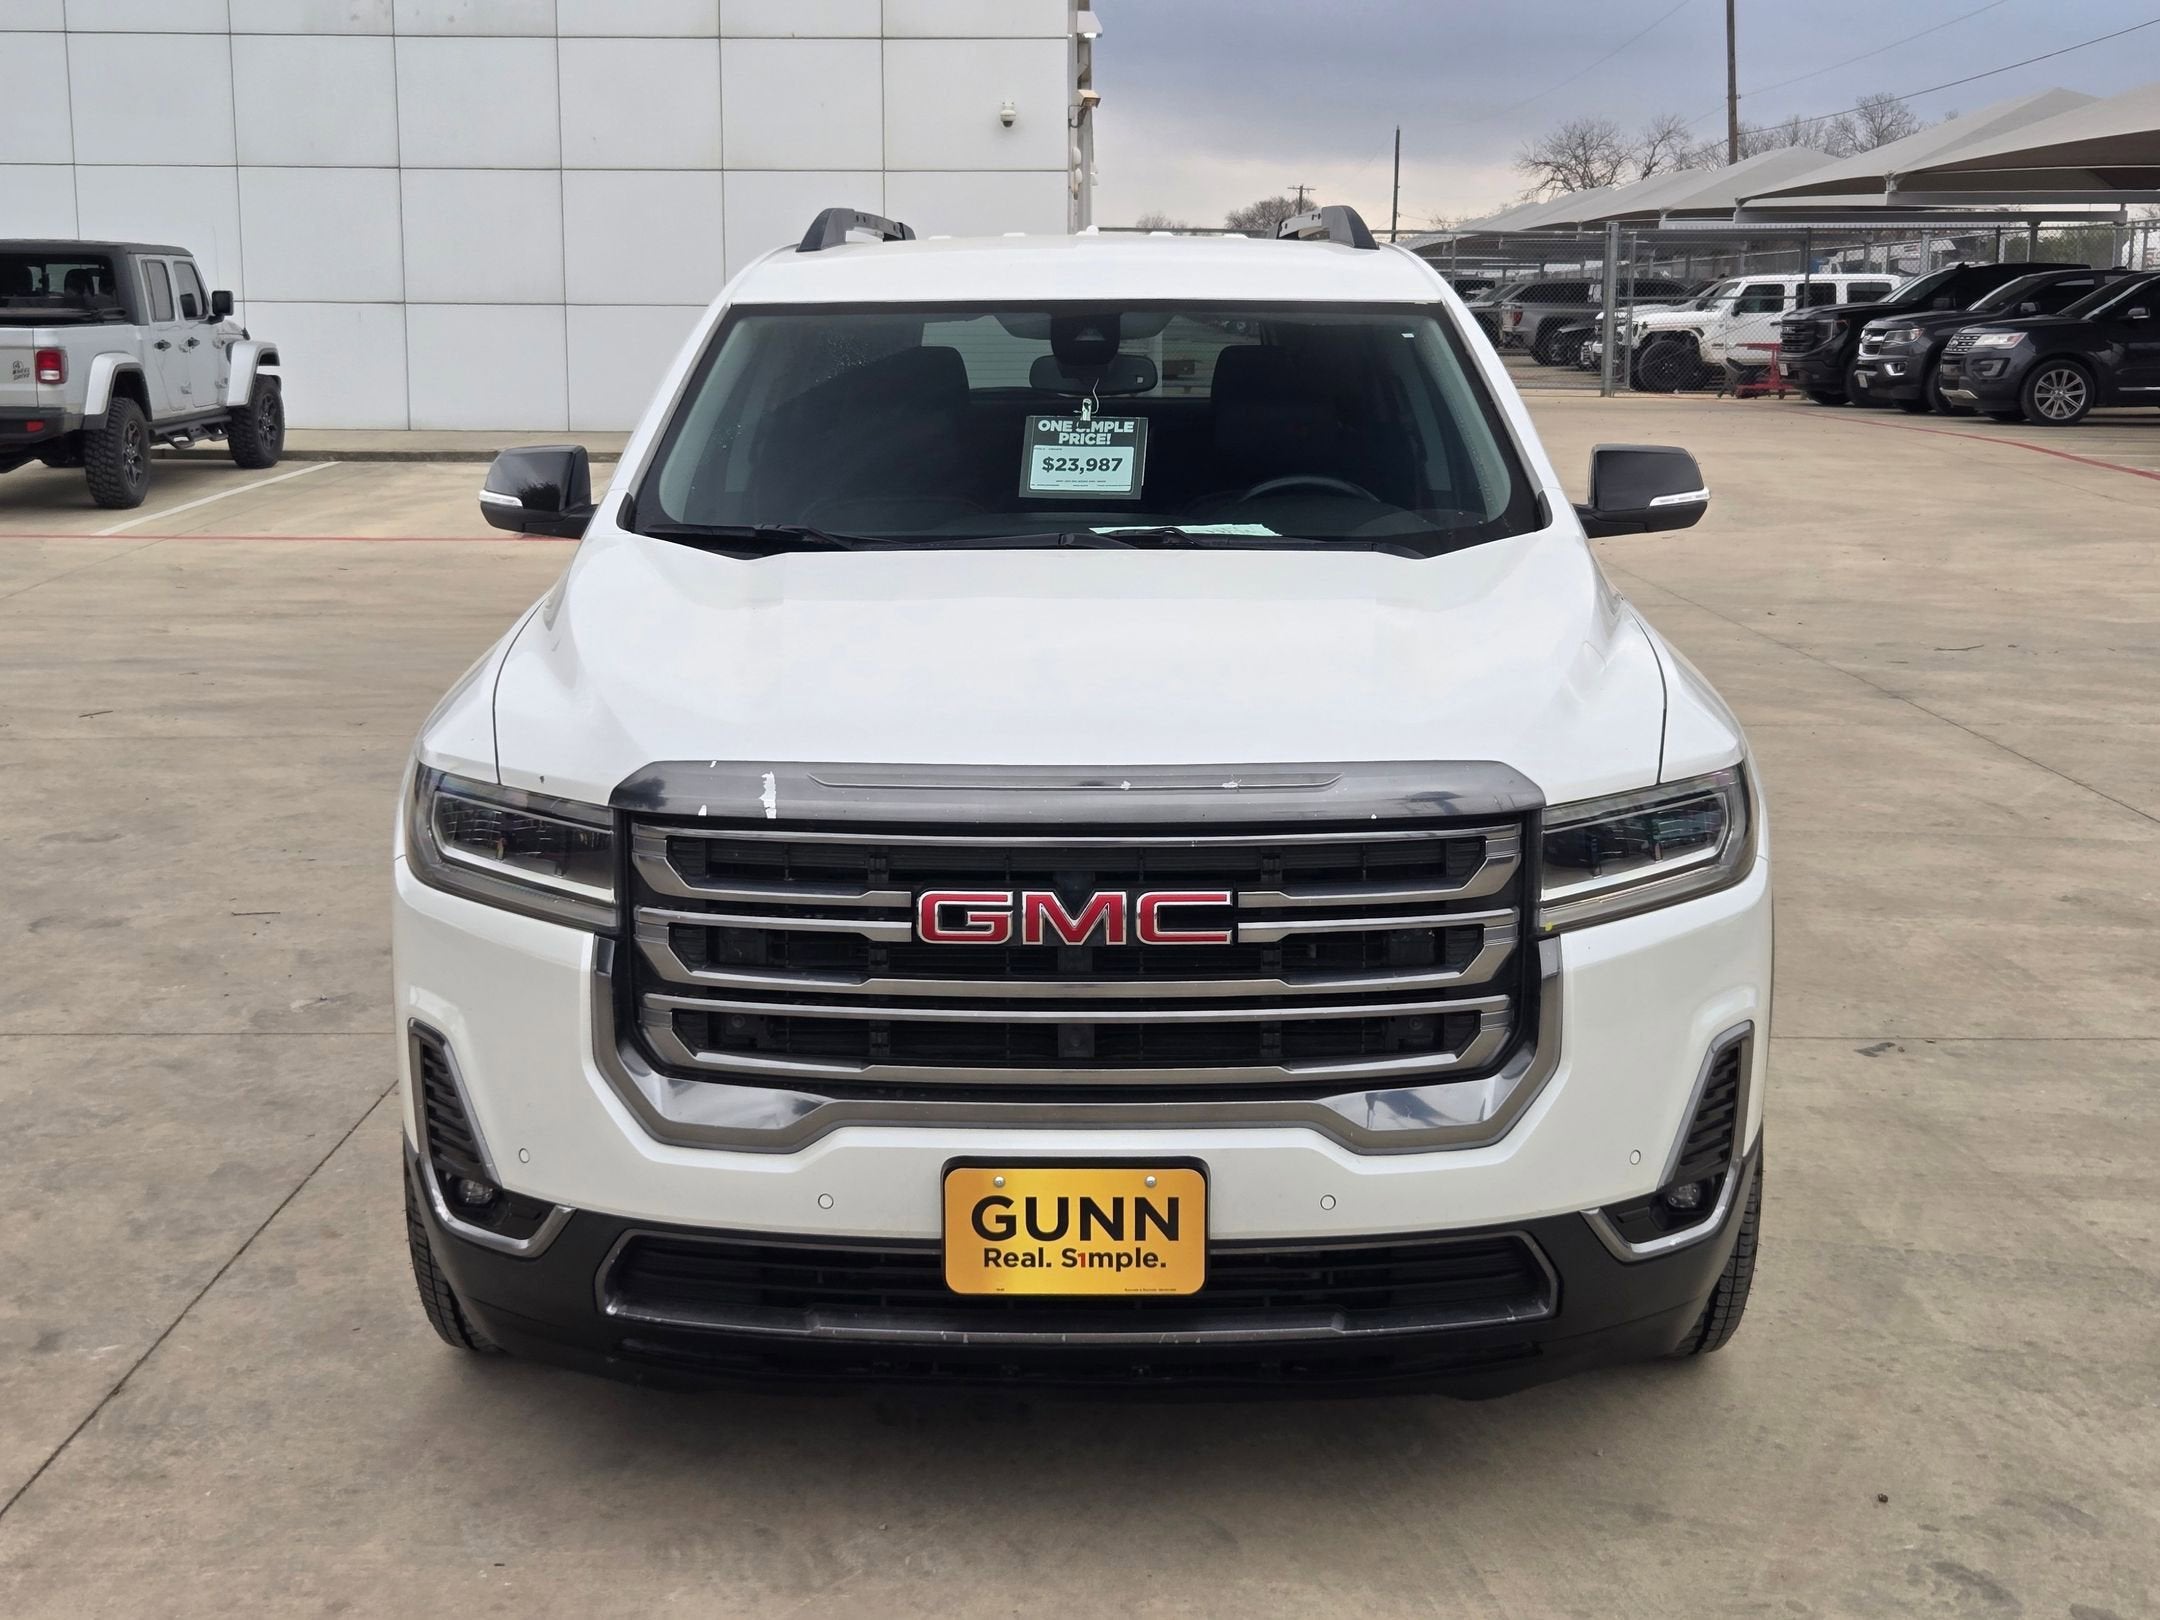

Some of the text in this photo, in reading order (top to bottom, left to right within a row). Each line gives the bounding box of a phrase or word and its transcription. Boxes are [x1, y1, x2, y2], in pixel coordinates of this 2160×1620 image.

[1038, 420, 1135, 433] ONE MPLE
[1058, 433, 1112, 445] PRICE!
[1042, 456, 1123, 475] $23,987
[918, 890, 1233, 945] GMC
[971, 1195, 1180, 1242] GUNN
[983, 1247, 1053, 1268] Real.
